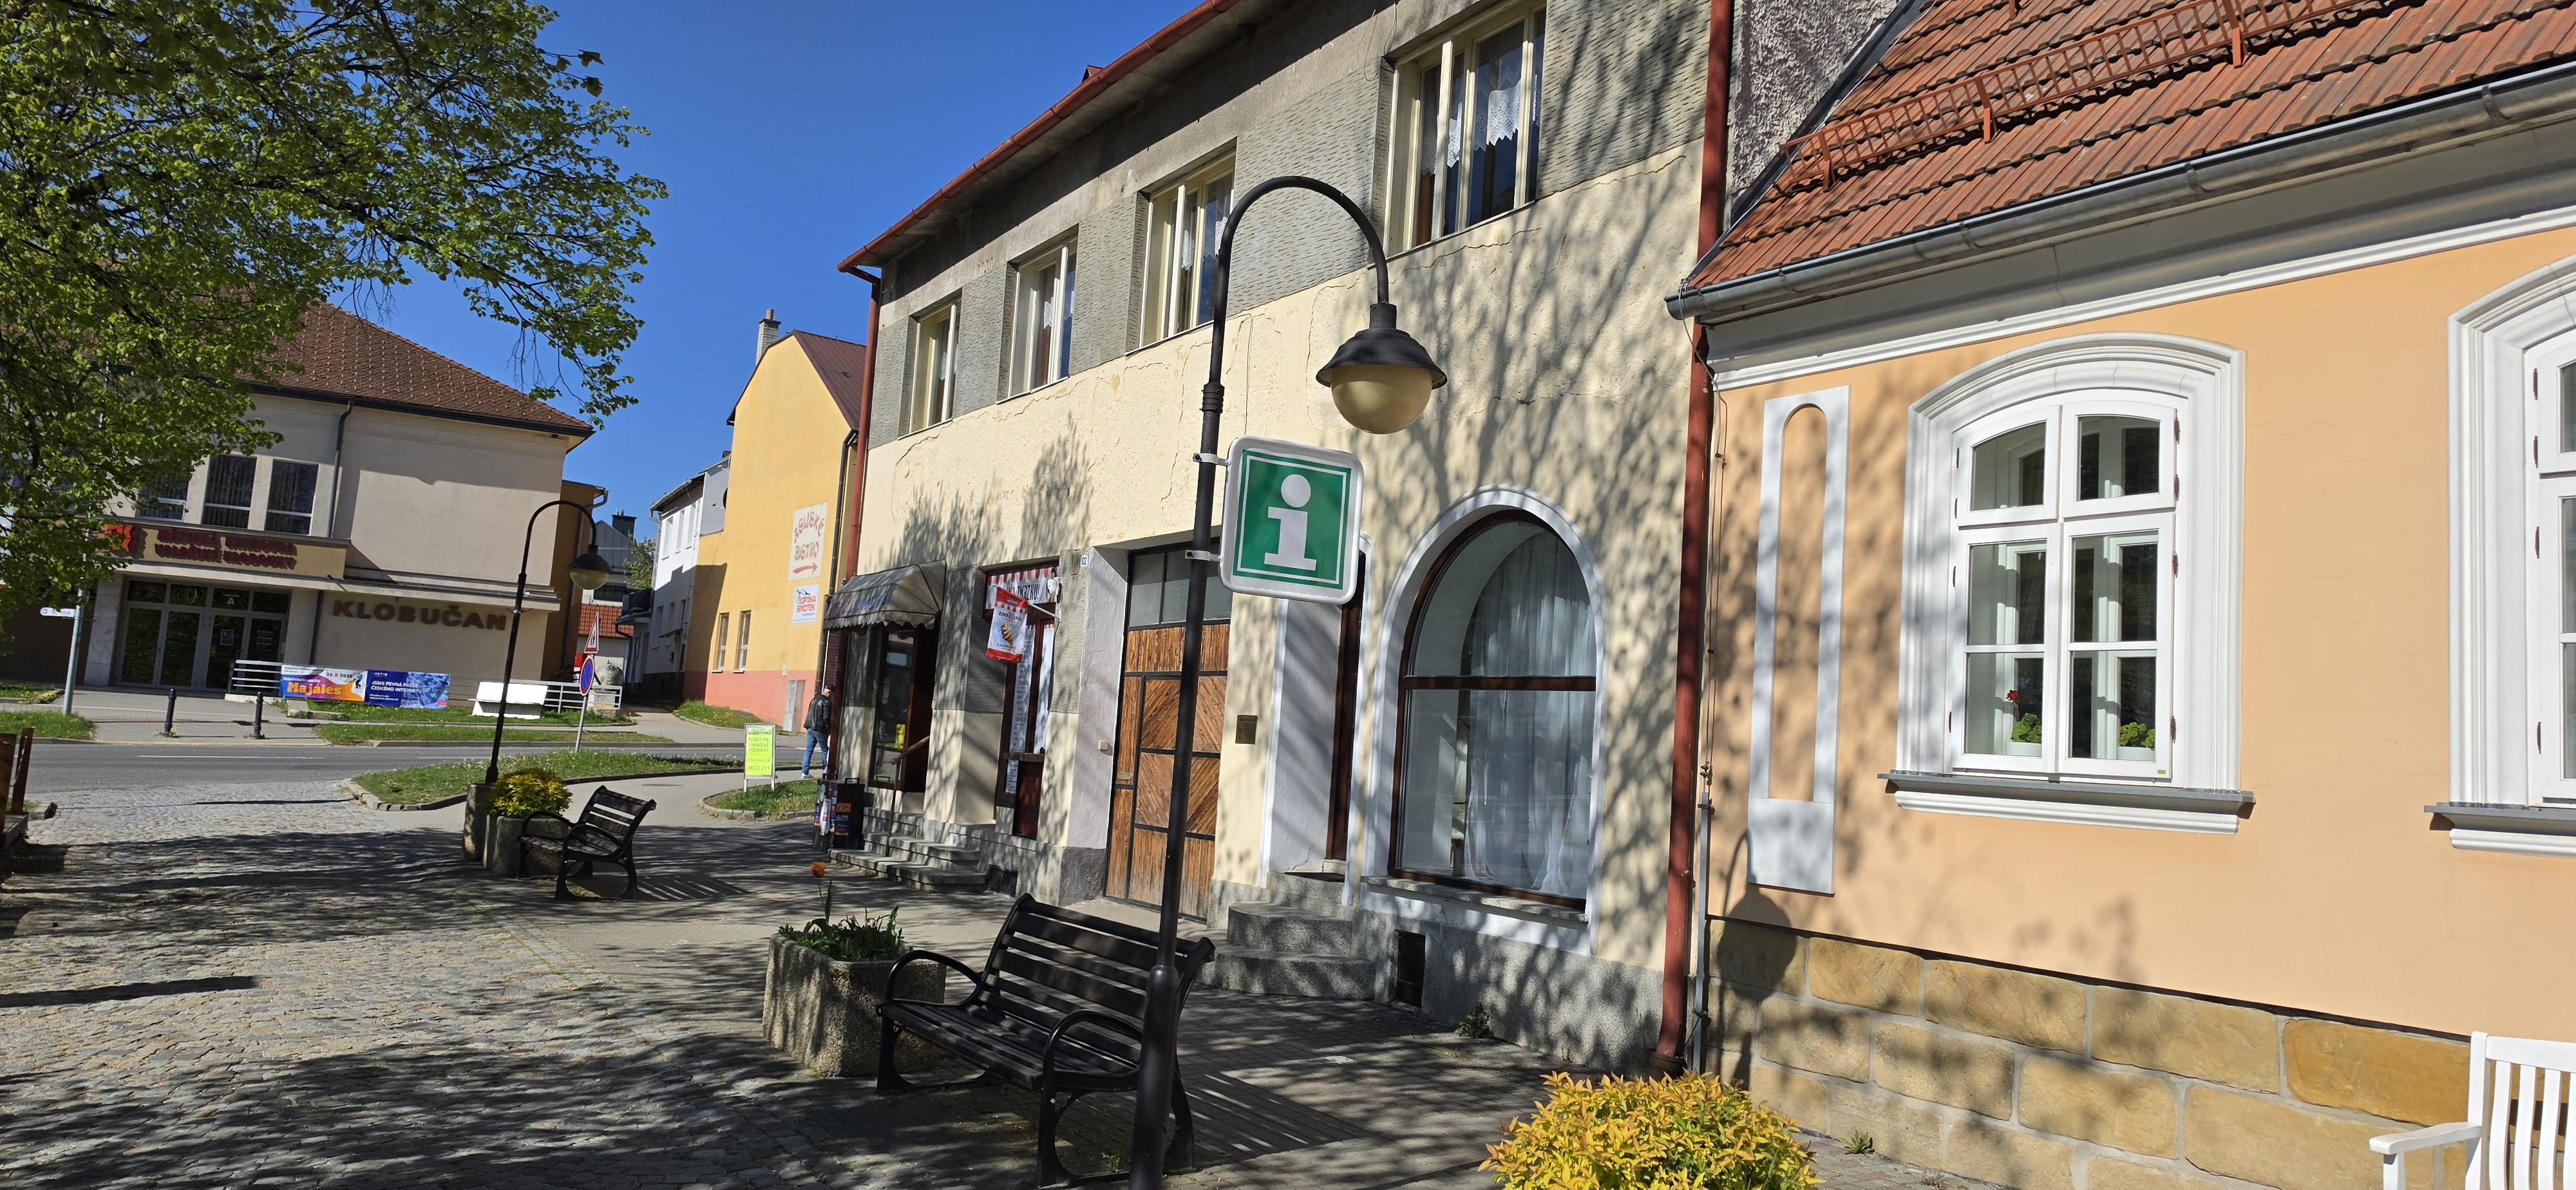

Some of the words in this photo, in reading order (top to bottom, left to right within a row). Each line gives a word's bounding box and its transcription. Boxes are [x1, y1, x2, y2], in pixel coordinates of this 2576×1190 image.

[794, 542, 819, 562] BISTRO
[800, 595, 816, 604] OPTIKA
[797, 604, 816, 613] SMOTEK
[332, 600, 507, 631] KLOBUČAN
[998, 611, 1022, 621] ZMRZLINA
[287, 681, 342, 696] Majáles
